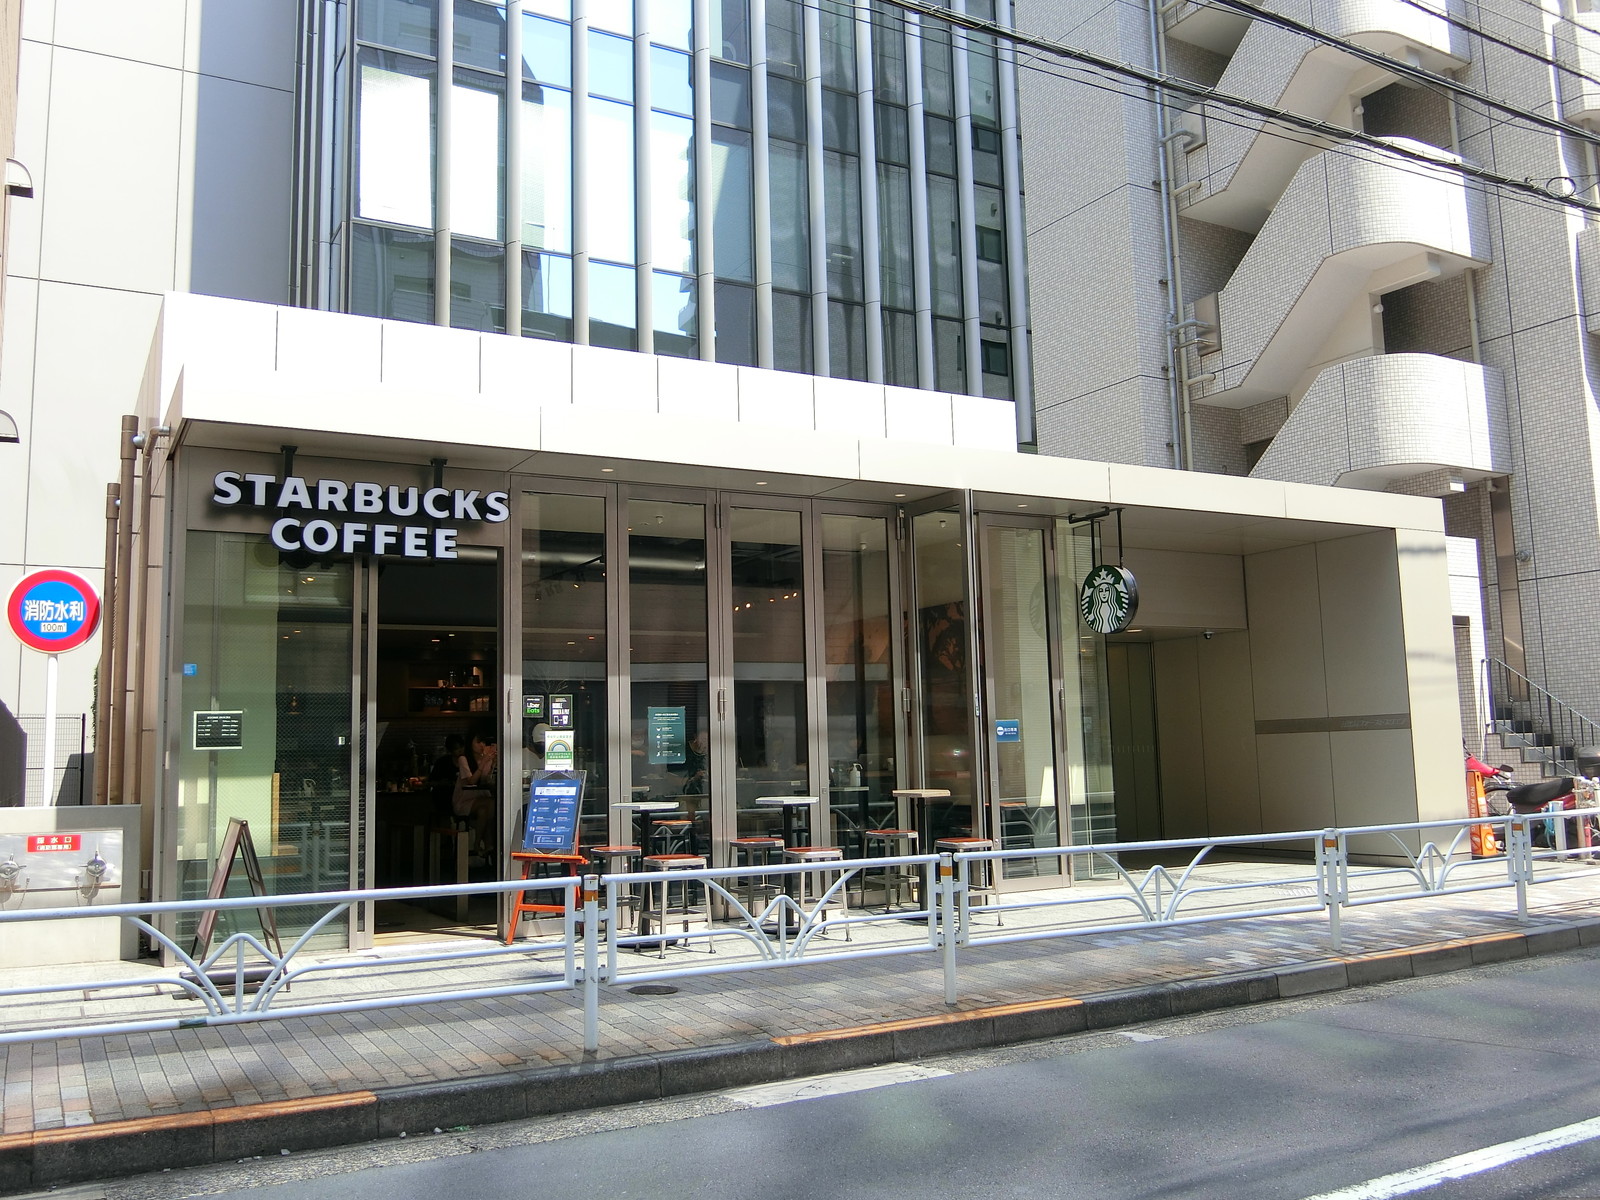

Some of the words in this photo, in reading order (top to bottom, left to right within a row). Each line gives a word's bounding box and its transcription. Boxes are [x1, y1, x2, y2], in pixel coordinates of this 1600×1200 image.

[213, 471, 510, 522] STARBUCKS
[271, 517, 458, 559] COFFEE
[24, 600, 84, 621] 消防水利
